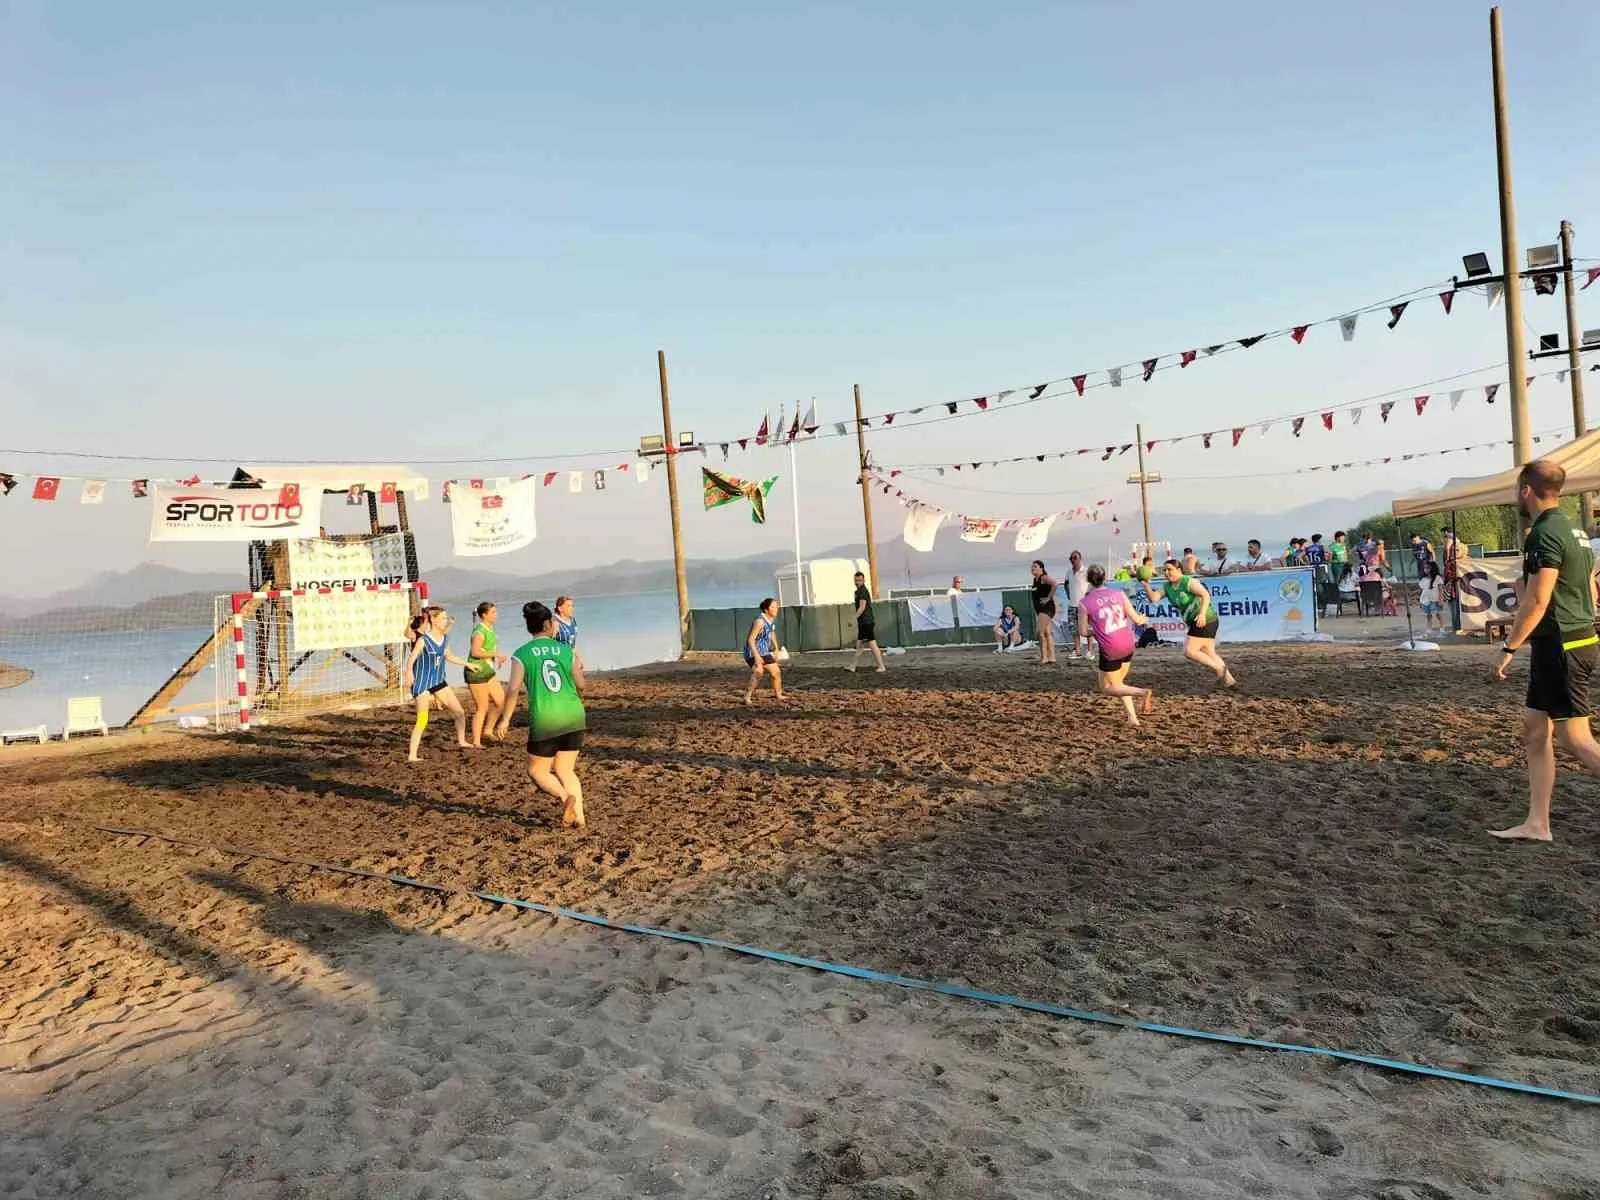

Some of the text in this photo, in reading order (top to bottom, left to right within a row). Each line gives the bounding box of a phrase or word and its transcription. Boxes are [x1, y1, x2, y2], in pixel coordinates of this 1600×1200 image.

[1212, 585, 1231, 597] RA
[1459, 571, 1519, 613] Sa
[1145, 597, 1268, 618] LAR ERİM
[1152, 622, 1186, 632] ERDO
[543, 659, 562, 693] 6
